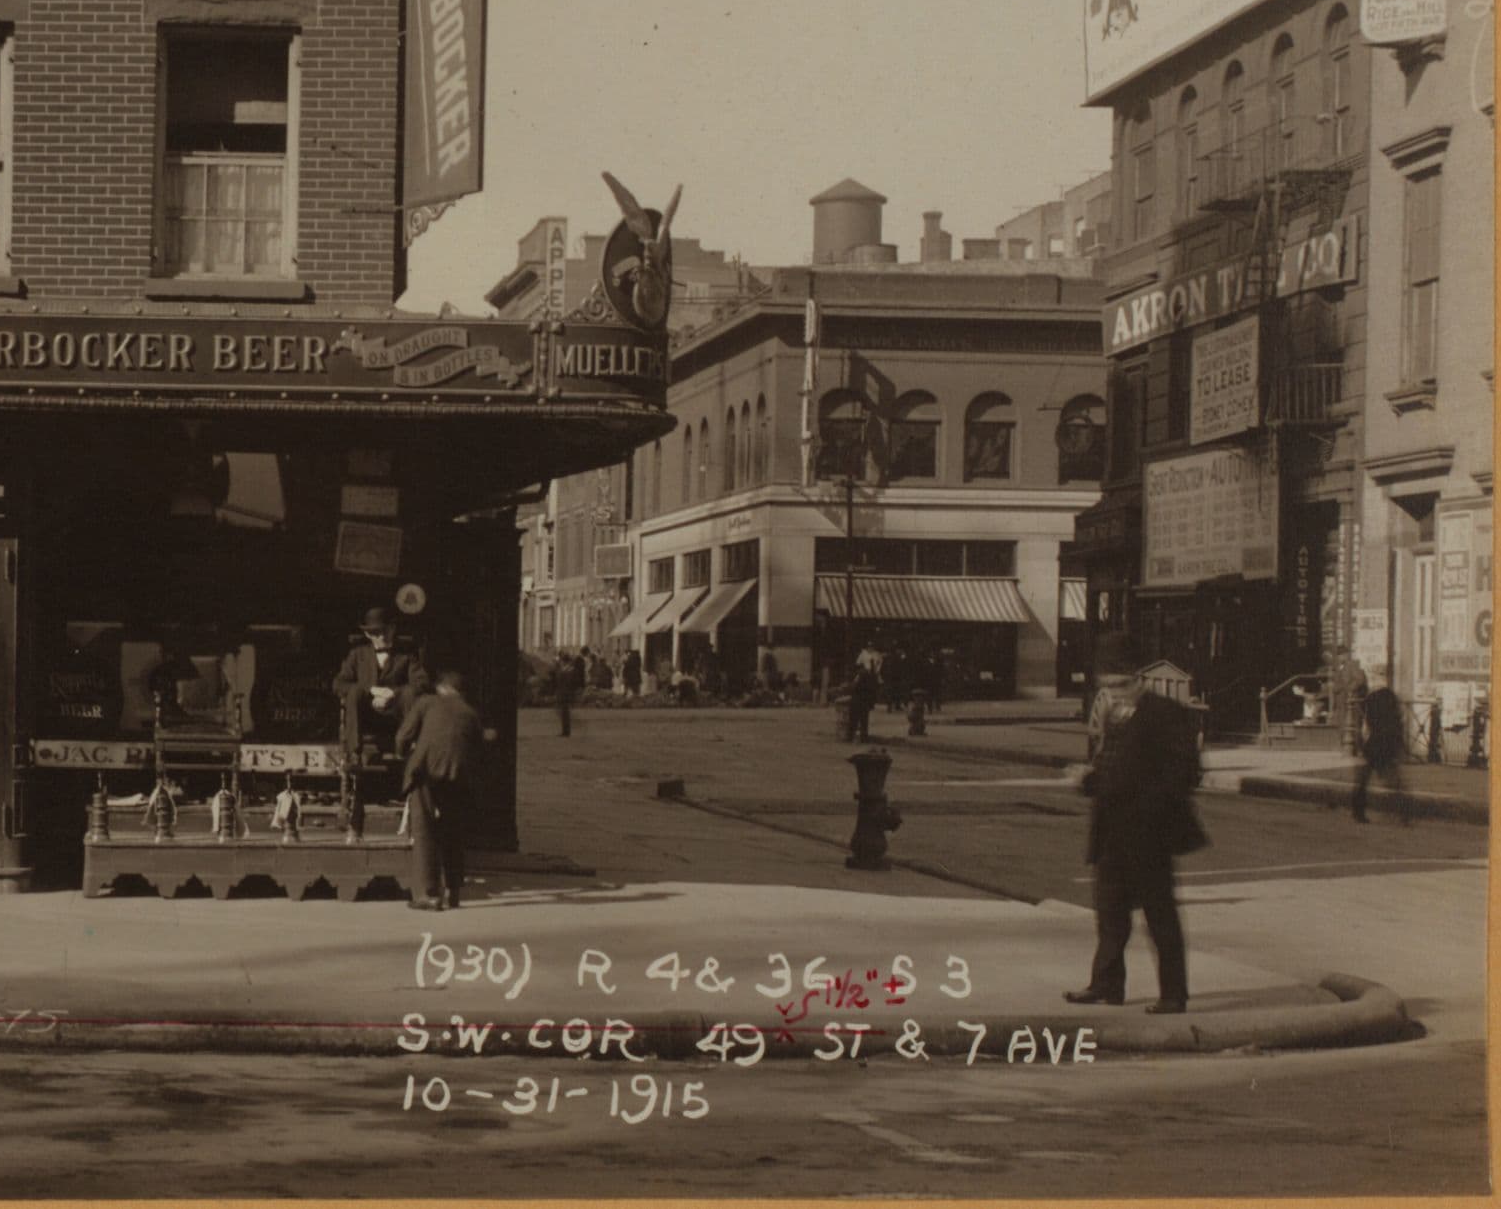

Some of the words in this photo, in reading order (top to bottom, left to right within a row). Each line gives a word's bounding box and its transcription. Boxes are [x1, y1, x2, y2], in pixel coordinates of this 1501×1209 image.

[1111, 274, 1208, 346] AKRON
[213, 334, 328, 374] BEER
[1196, 375, 1211, 398] TO
[1213, 362, 1251, 392] LEASE
[1296, 544, 1309, 590] AUTO
[53, 747, 113, 771] JAC.
